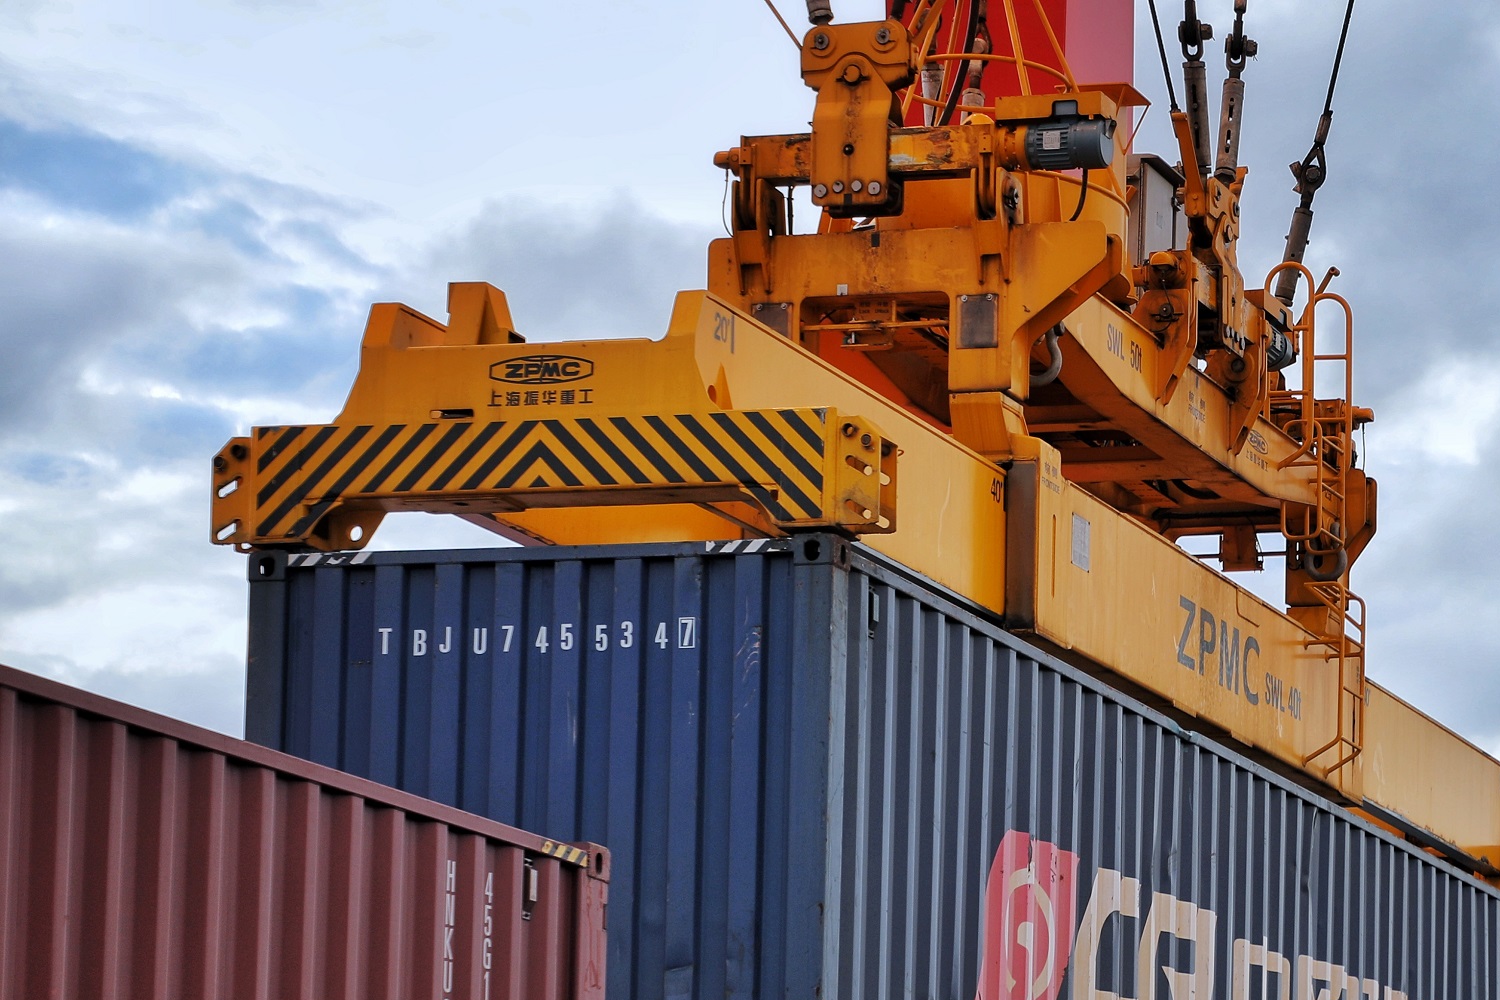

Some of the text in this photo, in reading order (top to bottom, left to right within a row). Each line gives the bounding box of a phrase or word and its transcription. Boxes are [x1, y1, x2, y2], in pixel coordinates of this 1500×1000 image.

[1107, 323, 1142, 373] SWL 50t
[504, 361, 581, 378] ZPMC
[487, 389, 594, 407] 上海振华重工
[1177, 594, 1302, 721] ZPMC SWL 40t
